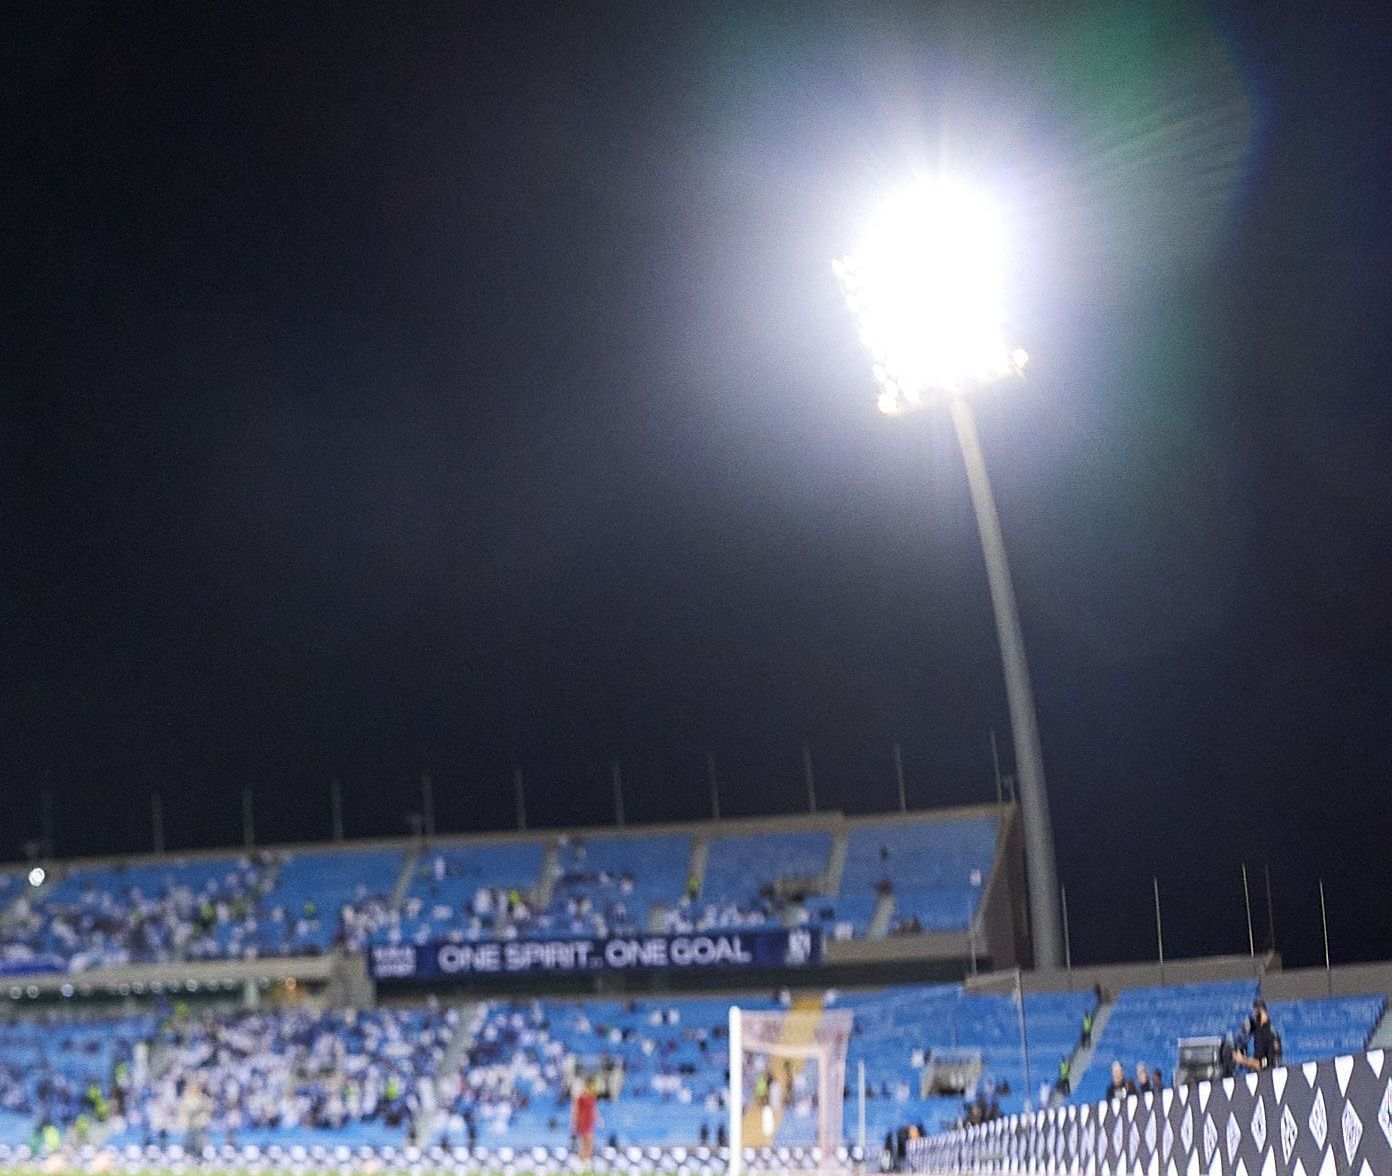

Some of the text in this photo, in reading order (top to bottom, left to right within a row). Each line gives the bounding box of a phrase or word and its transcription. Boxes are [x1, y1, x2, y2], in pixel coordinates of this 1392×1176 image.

[438, 945, 501, 973] ONE
[605, 938, 667, 968] ONE
[670, 936, 751, 966] GOAL
